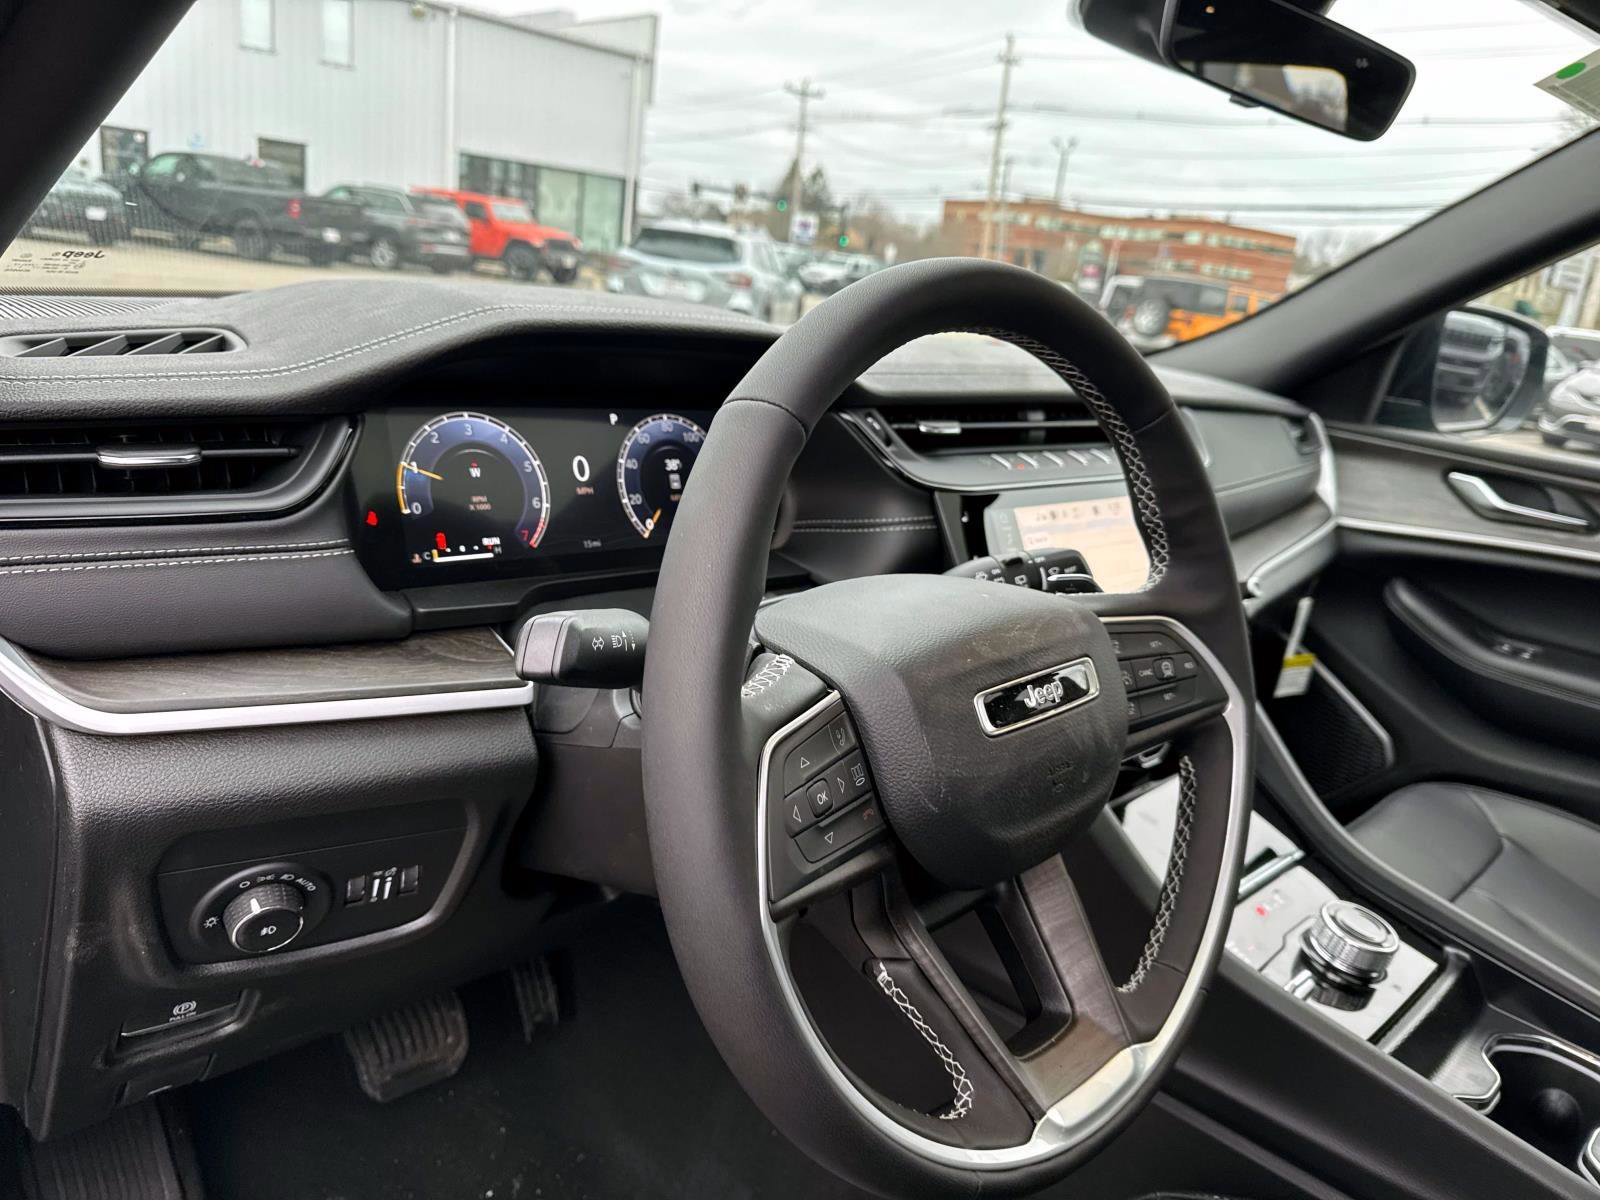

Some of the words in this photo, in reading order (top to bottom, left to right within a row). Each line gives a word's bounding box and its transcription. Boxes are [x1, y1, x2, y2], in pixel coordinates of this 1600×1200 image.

[609, 413, 618, 425] P
[464, 423, 473, 436] 3
[430, 431, 440, 444] 2
[500, 433, 508, 445] 4
[523, 461, 532, 473] 5
[572, 455, 590, 482] 0
[625, 459, 639, 470] 40
[469, 467, 481, 478] W
[531, 497, 541, 509] 6
[629, 494, 642, 505] 20
[411, 502, 422, 515] 0
[645, 518, 654, 530] 0
[521, 529, 529, 541] 7
[481, 537, 501, 546] RUN
[423, 552, 431, 560] C
[494, 546, 502, 554] H
[1023, 680, 1064, 708] Jeep
[816, 790, 829, 805] OK
[295, 877, 316, 892] AUTO
